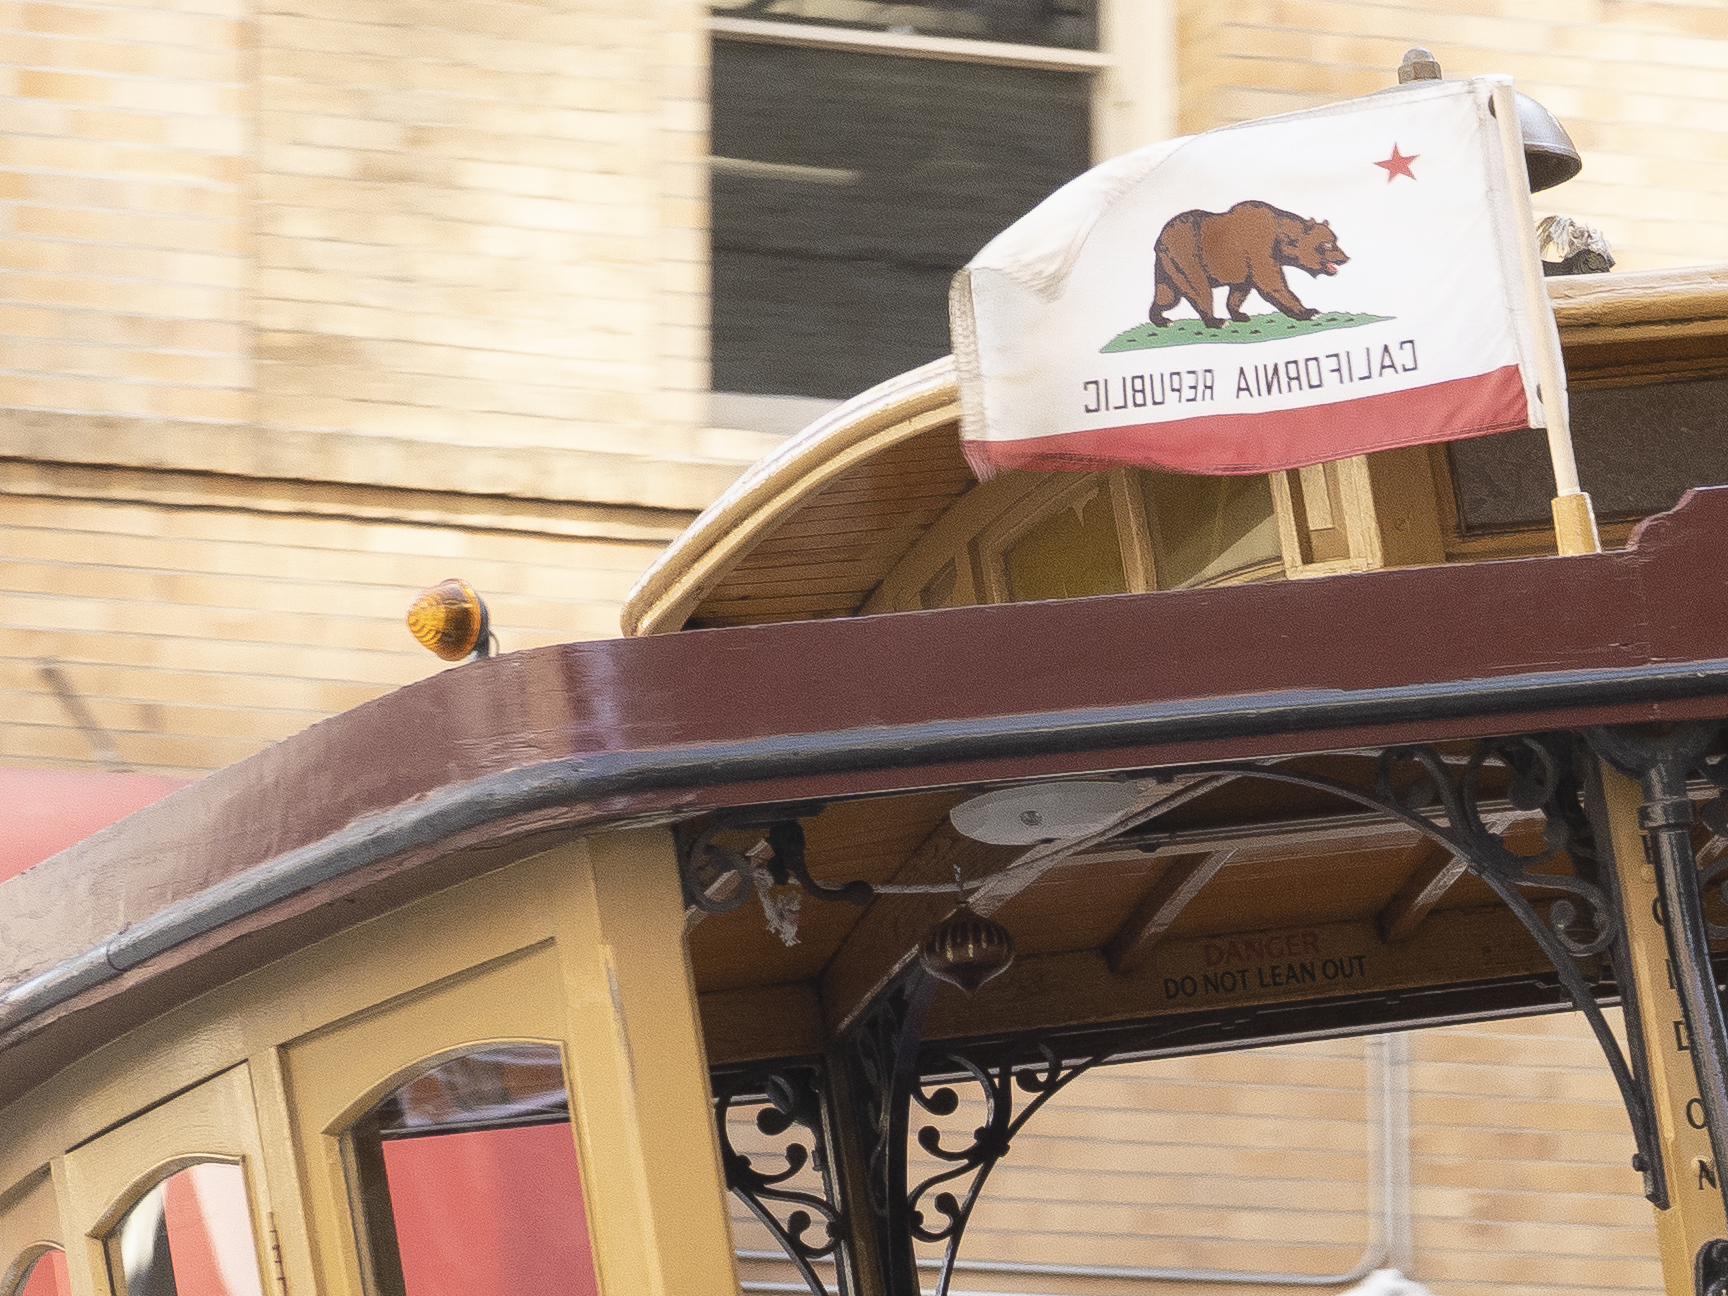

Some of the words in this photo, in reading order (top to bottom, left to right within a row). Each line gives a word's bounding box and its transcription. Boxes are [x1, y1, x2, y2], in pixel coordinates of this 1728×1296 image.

[1202, 930, 1321, 968] DANGER
[1162, 975, 1198, 1000] DO
[1202, 968, 1249, 995] NOT
[1257, 961, 1317, 989] LEAN
[1321, 954, 1367, 980] OUT
